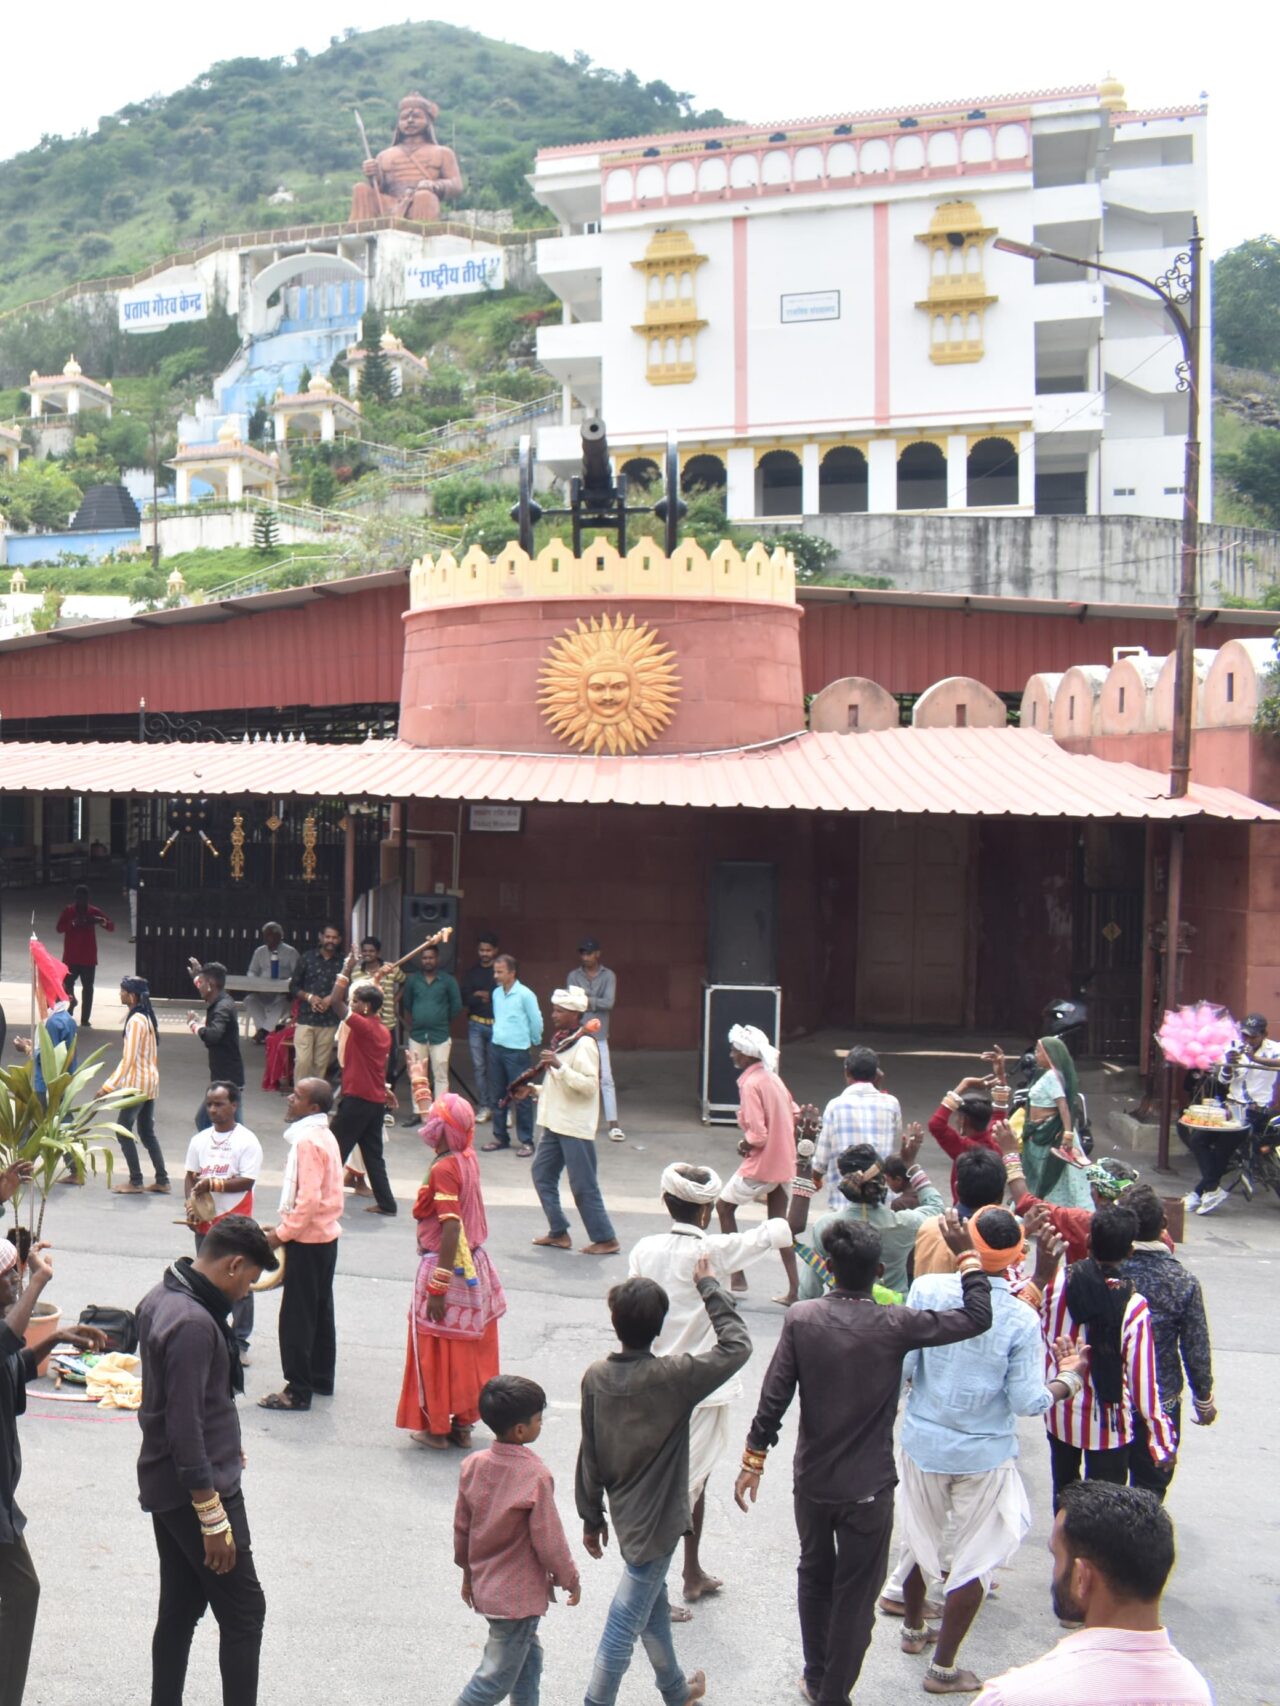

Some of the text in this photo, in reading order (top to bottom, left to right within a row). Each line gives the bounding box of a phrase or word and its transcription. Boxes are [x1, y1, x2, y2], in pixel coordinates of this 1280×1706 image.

[124, 290, 202, 320] प्रताप गौरव केन्द्र
